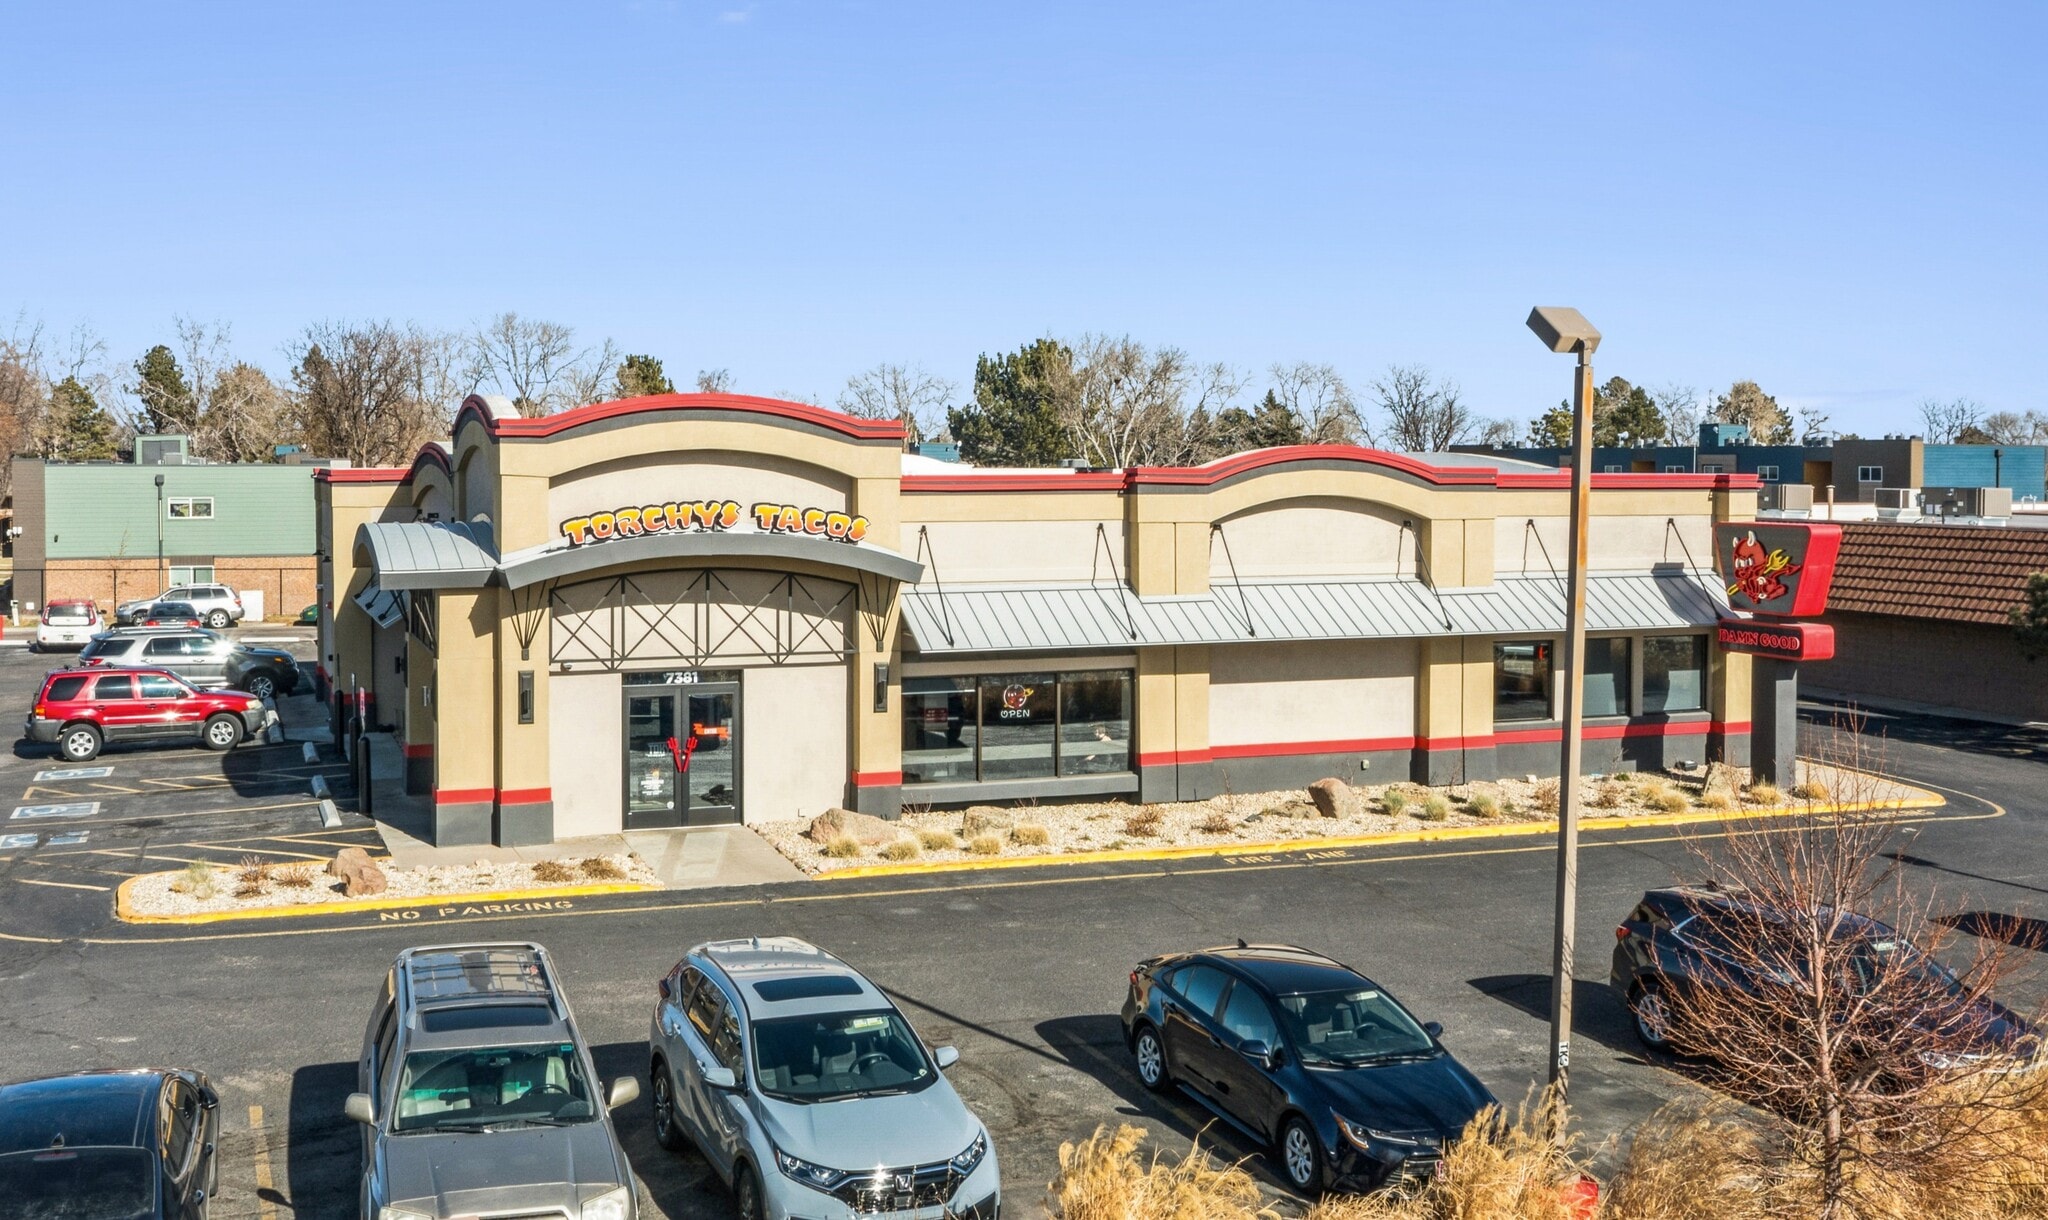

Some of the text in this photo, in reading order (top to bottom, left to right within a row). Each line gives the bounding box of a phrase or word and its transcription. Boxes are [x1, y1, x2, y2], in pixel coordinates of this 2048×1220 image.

[560, 500, 872, 546] TORCHYS TACOS
[1719, 628, 1800, 651] DAMN GOOD
[665, 671, 698, 684] 7381
[1000, 709, 1031, 719] OPEN
[379, 900, 574, 921] NO PARKING
